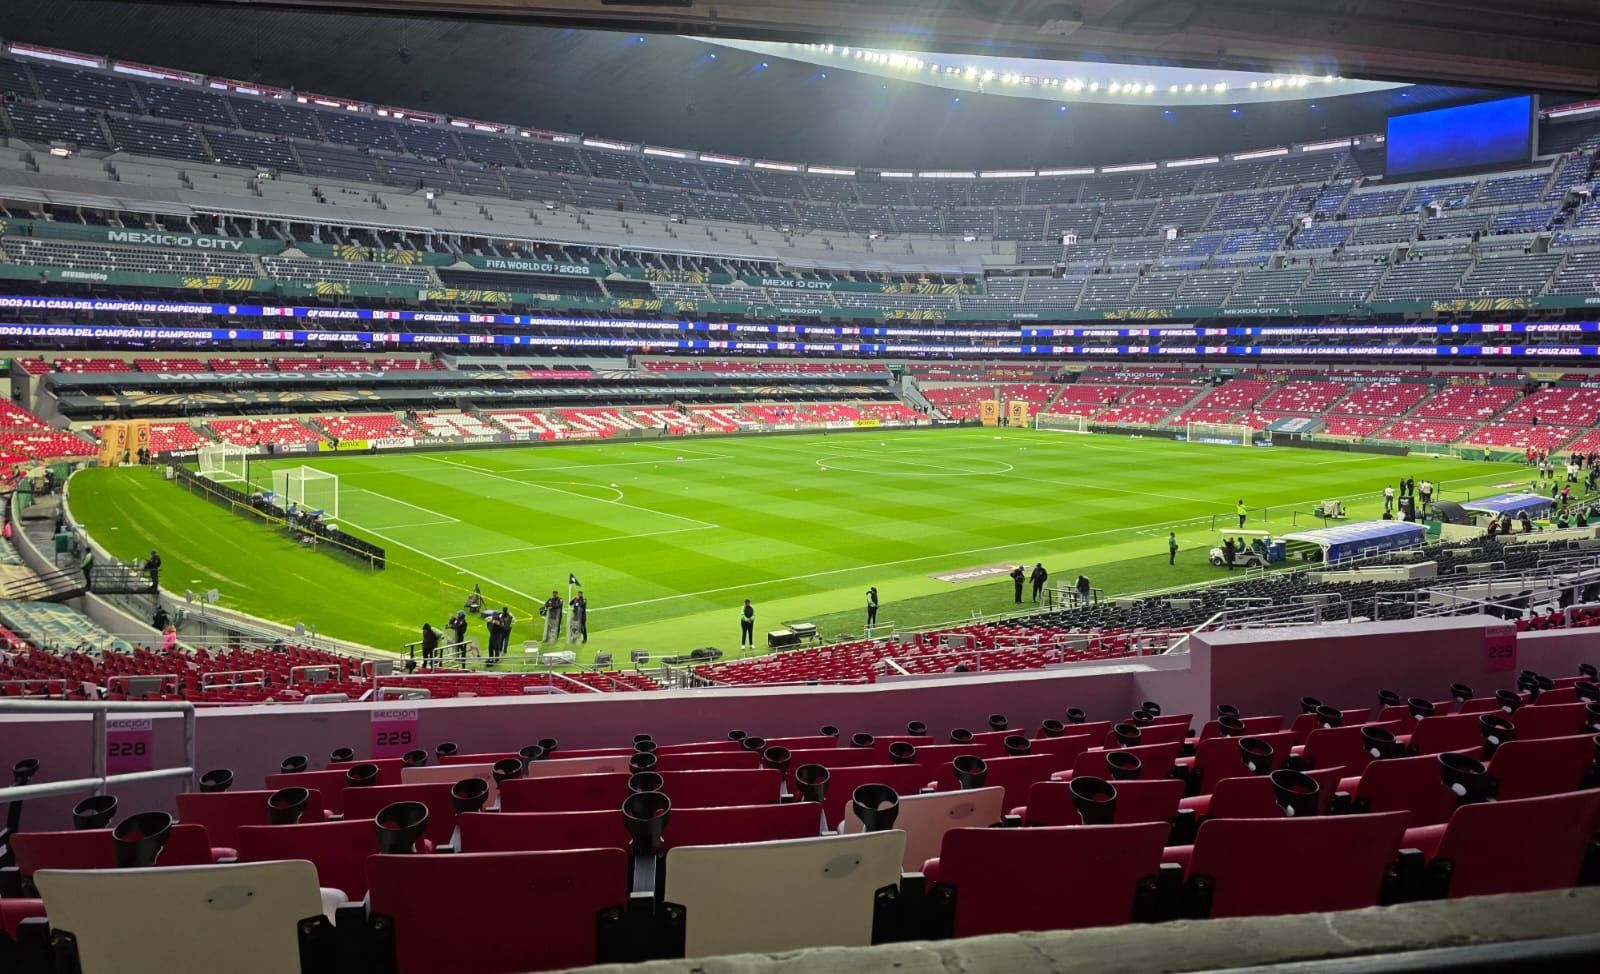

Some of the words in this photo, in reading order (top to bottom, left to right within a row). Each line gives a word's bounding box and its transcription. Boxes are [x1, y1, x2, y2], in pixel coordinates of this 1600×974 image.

[108, 231, 193, 247] MEXICO
[196, 238, 243, 250] CITY
[486, 260, 506, 269] FIFA
[507, 261, 540, 271] WORLD
[559, 265, 590, 274] 2026
[807, 281, 832, 289] CITY
[23, 299, 31, 307] A
[32, 300, 46, 308] LA
[95, 302, 142, 311] CAMPEÓN
[157, 304, 213, 313] CAMPEONES
[319, 310, 340, 318] CRUZ
[340, 311, 359, 319] AZUL
[23, 327, 31, 335] A
[32, 327, 46, 335] LA
[47, 328, 74, 336] CASA
[74, 328, 94, 337] DEL
[95, 328, 142, 338] CAMPEÓN
[143, 329, 156, 338] DE
[157, 330, 213, 339] CAMPEONES
[1349, 326, 1383, 334] CAMPEÓN
[307, 333, 318, 341] CF
[319, 333, 340, 341] CRUZ
[340, 334, 359, 342] AZUL
[157, 372, 305, 380] MEXICO
[311, 371, 385, 379] CITY
[485, 388, 565, 396] MNDIAL
[338, 439, 360, 447] emix
[1489, 645, 1513, 658] 229
[376, 731, 412, 745] 229
[109, 742, 146, 756] 228
